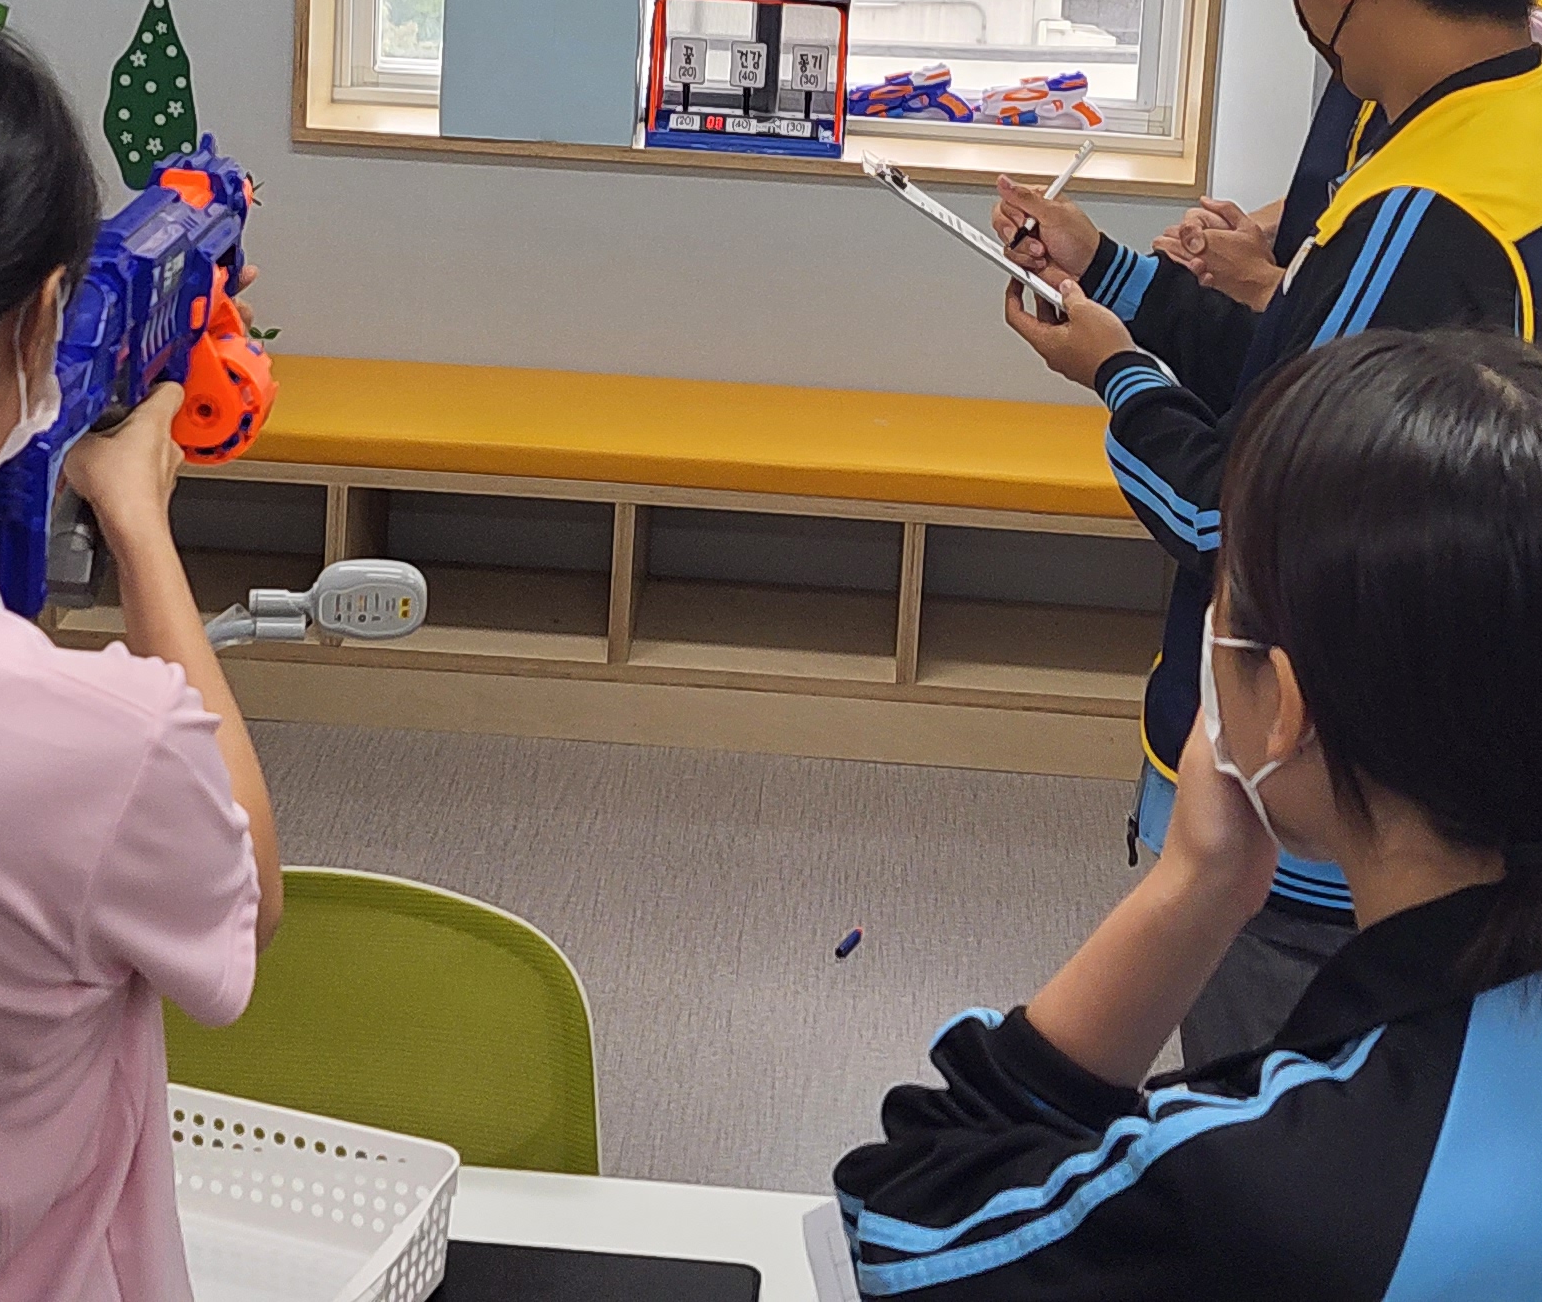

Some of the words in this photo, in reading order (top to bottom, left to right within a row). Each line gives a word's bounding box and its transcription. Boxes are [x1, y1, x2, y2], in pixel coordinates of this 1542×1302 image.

[736, 49, 762, 71] 건강
[798, 53, 823, 74] 동기
[678, 65, 697, 80] (20)
[738, 70, 758, 84] (40)
[799, 74, 819, 88] (30)
[675, 115, 695, 128] (20)
